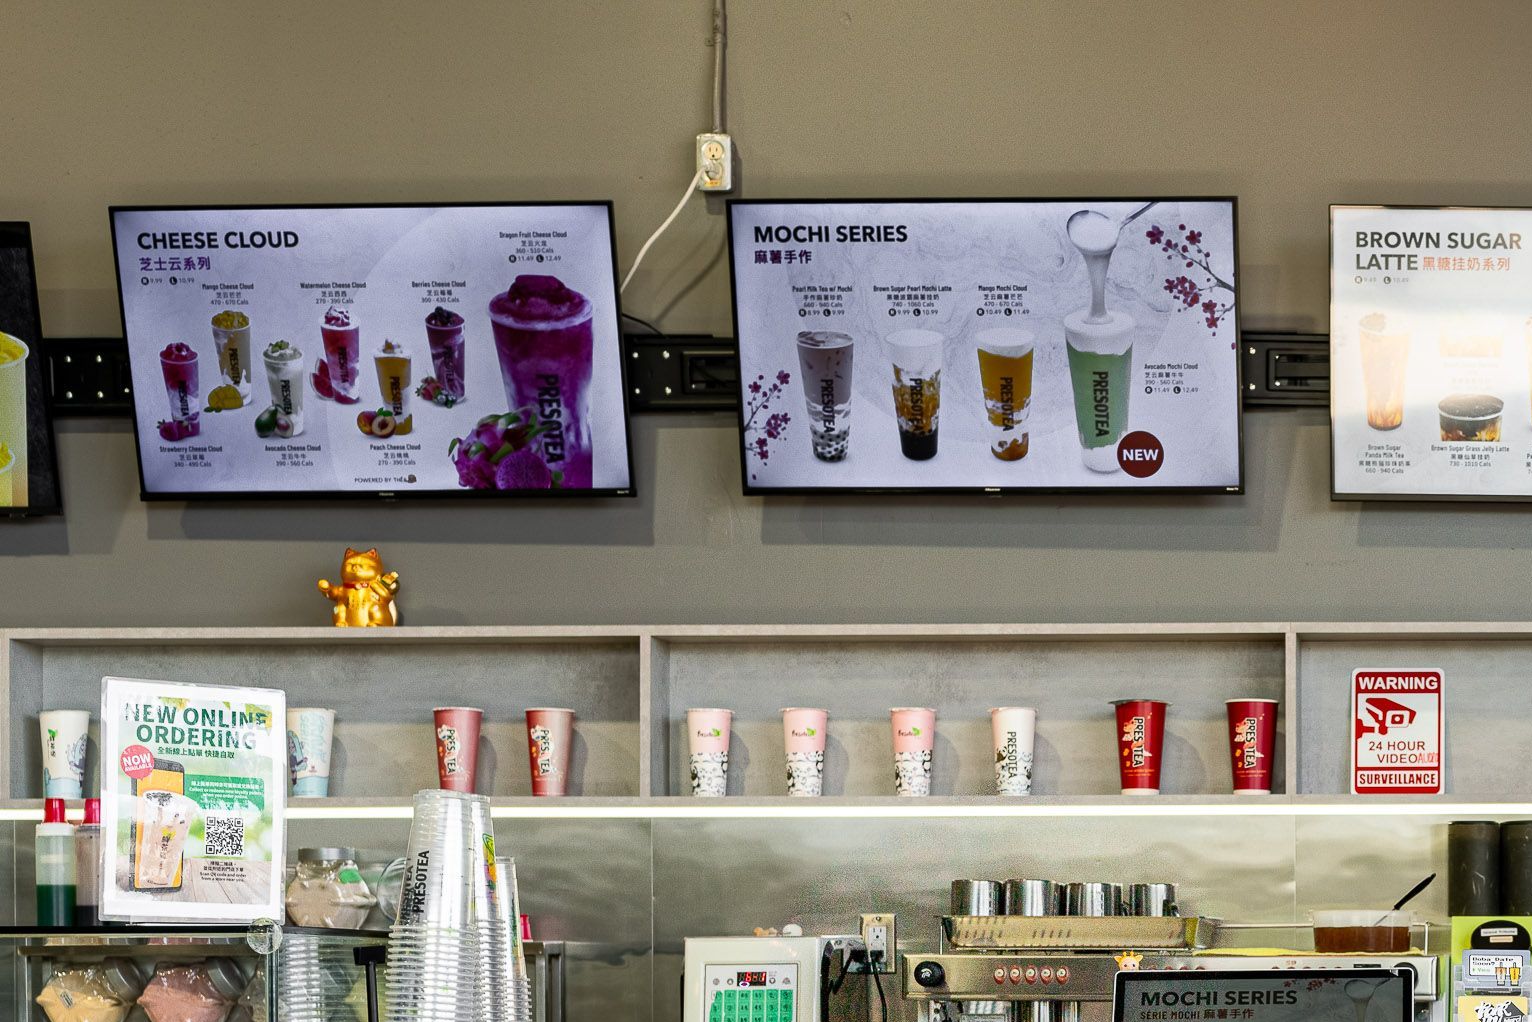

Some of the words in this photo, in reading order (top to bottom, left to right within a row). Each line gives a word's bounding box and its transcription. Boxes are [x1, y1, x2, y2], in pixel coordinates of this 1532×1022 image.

[137, 232, 219, 250] CHEESE
[224, 231, 299, 249] CLOUD
[754, 226, 830, 243] MOCHI
[836, 225, 908, 243] SERIES
[1355, 232, 1440, 249] BROWN
[1448, 232, 1522, 250] SUGAR
[139, 256, 211, 271] 芝士云系列
[754, 250, 812, 264] 麻薯手作
[1355, 254, 1418, 271] LATTE
[1422, 257, 1511, 272] 黑糖挂奶系列
[820, 379, 836, 433] PRESOTEA
[1000, 377, 1014, 432] PRESOTEA
[1092, 371, 1110, 437] PRESOTEA
[536, 374, 566, 464] PRESOTEA
[1122, 449, 1158, 461] NEW
[1358, 676, 1438, 690] WARNING
[125, 702, 177, 724] NEW
[184, 707, 268, 730] ONLINE
[136, 724, 257, 750] ORDERING
[1369, 741, 1382, 751] 24
[1388, 741, 1426, 751] HOUR
[122, 753, 151, 767] NOW
[1007, 731, 1018, 779] PRESOTEA
[1378, 753, 1418, 764] VIDEO
[1359, 774, 1436, 785] SURVEILLANCE
[412, 850, 430, 913] PRESOTEA
[1141, 990, 1218, 1006] MOCHI
[1224, 990, 1298, 1006] SERIES
[1170, 1010, 1200, 1020] MOCHI
[1203, 1008, 1255, 1020] 麻薯手作
